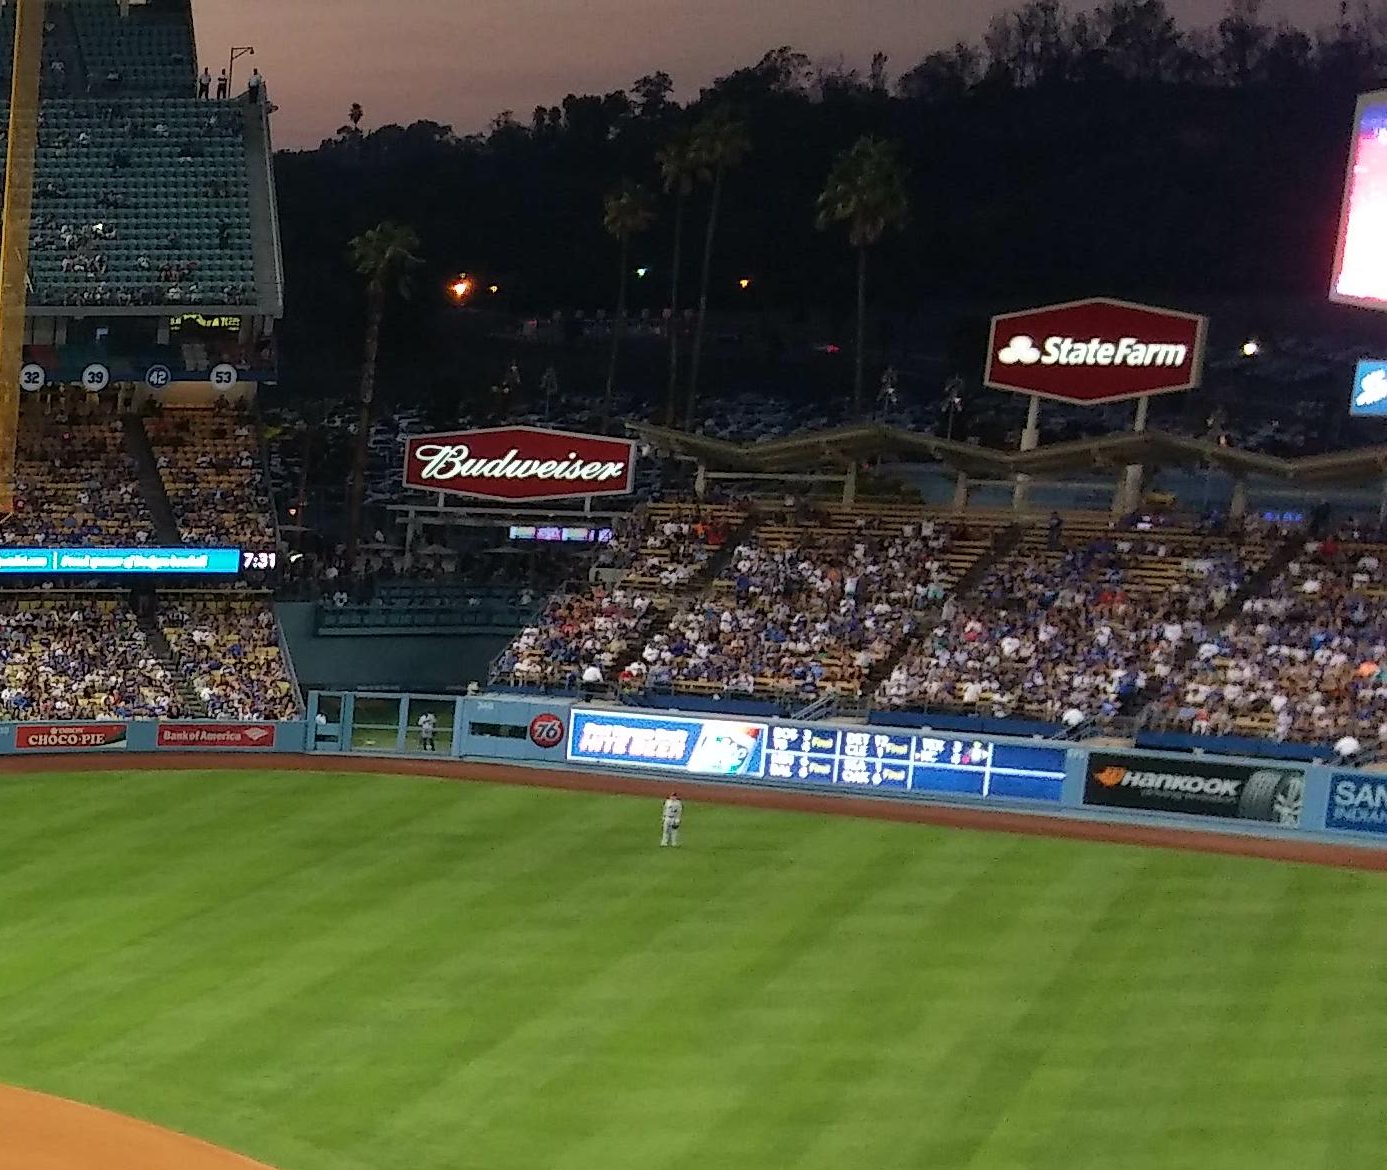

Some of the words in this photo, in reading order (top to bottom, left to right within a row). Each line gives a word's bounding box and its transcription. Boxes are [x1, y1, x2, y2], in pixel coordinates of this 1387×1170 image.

[23, 370, 40, 385] 32
[86, 369, 105, 385] 39
[148, 369, 167, 386] 42
[215, 369, 233, 385] 53
[415, 444, 625, 481] Budweiser
[244, 552, 276, 569] 7:31
[163, 730, 189, 741] Bank
[189, 730, 200, 741] of
[200, 730, 242, 742] America
[536, 721, 559, 739] 76
